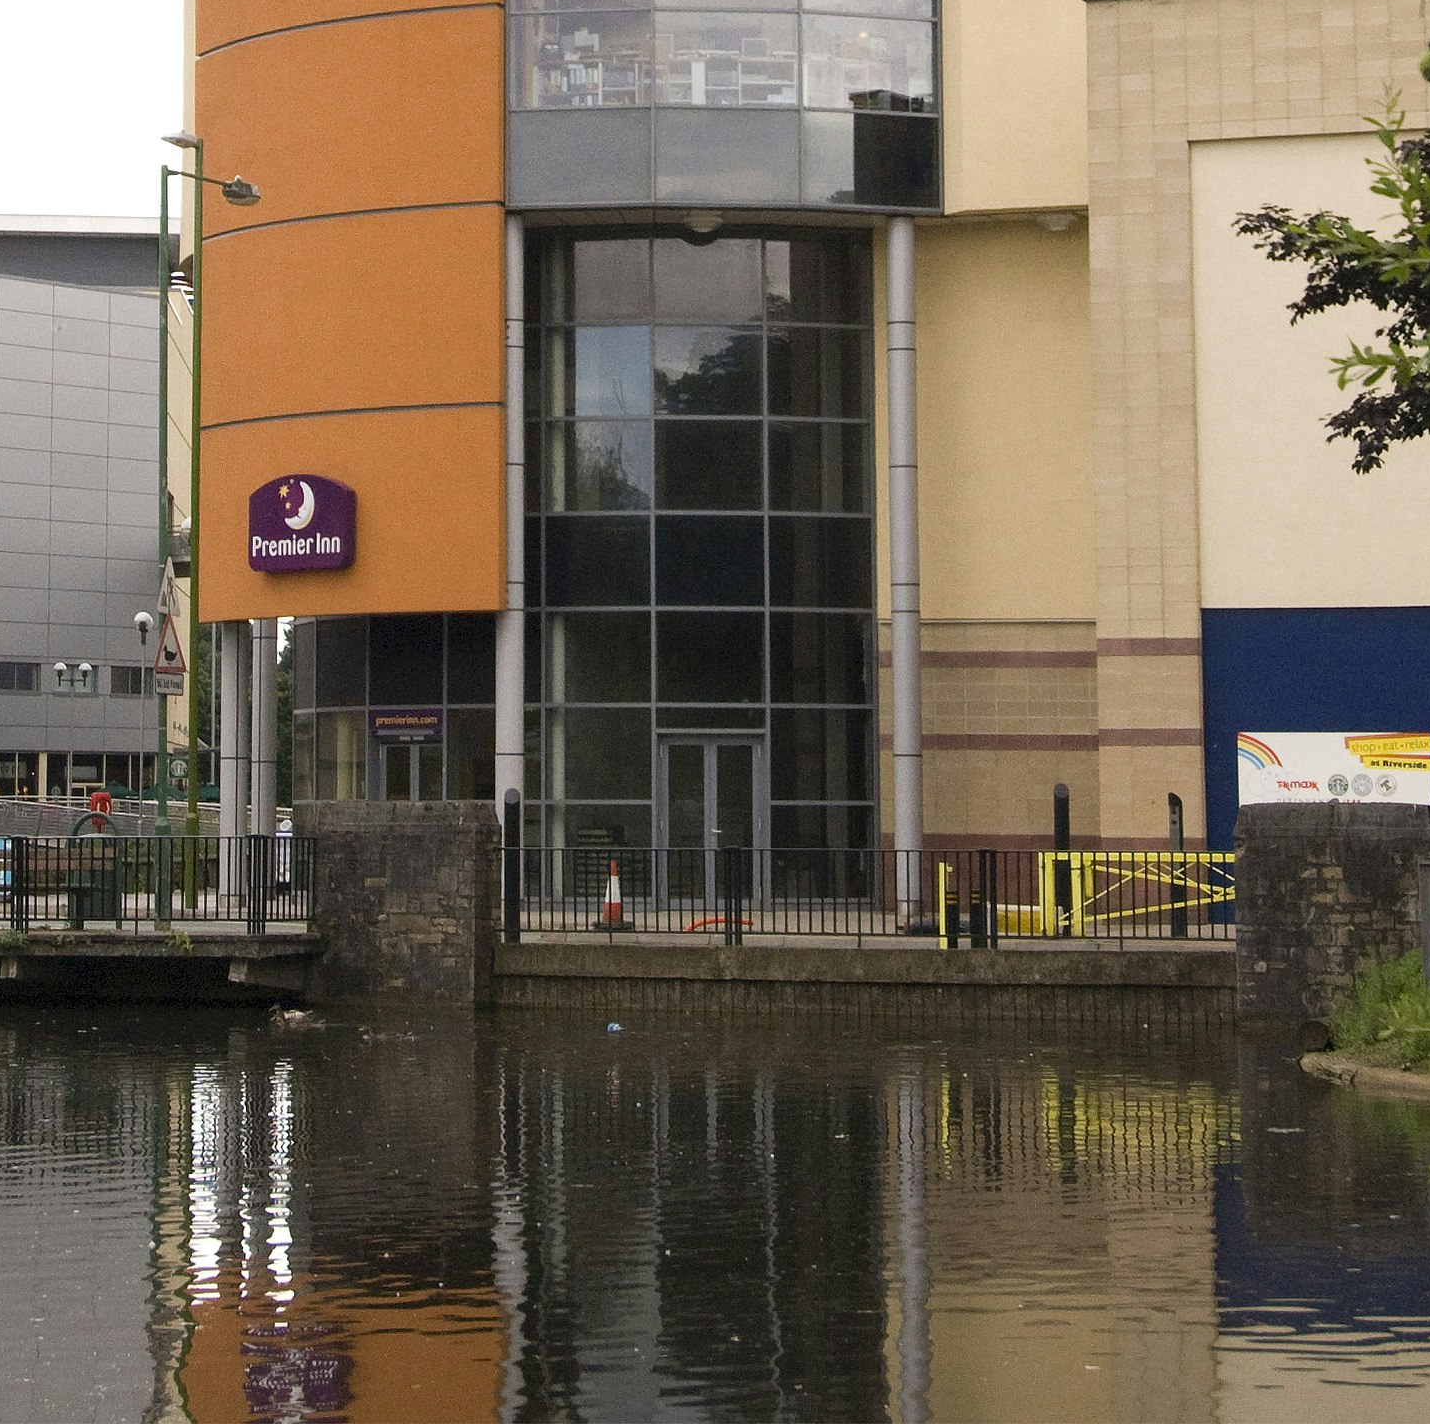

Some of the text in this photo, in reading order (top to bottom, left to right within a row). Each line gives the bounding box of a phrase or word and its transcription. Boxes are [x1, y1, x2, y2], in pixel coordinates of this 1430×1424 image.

[252, 532, 341, 557] Premier Inn
[1351, 738, 1430, 753] shop eat relax
[1382, 760, 1428, 770] Riverside
